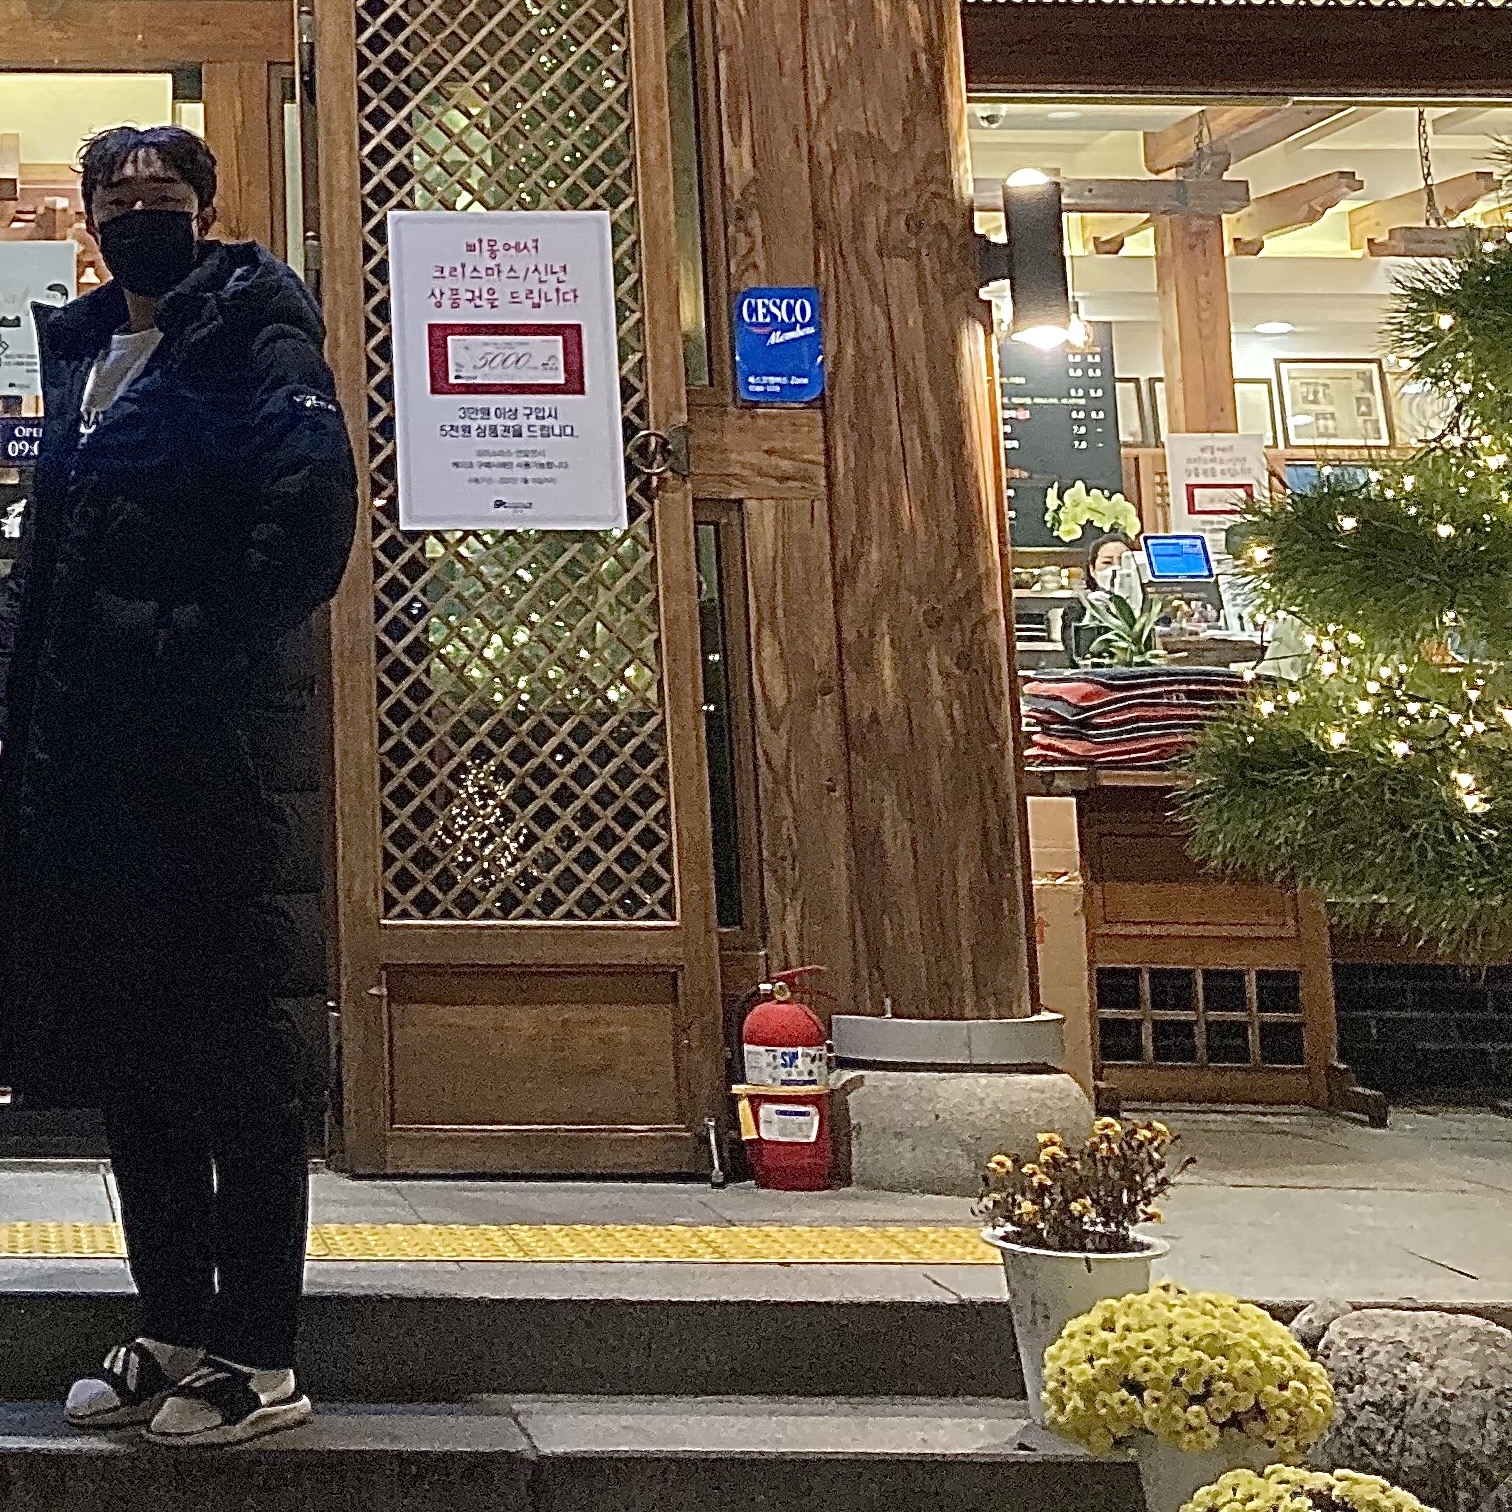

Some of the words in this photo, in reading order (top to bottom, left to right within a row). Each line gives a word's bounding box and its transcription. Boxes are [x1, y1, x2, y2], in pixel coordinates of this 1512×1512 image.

[427, 287, 499, 309] 상품권을
[508, 287, 579, 309] 드립니다
[742, 298, 812, 323] CESCO
[473, 352, 532, 370] 5000
[458, 406, 491, 420] 3만원
[494, 406, 518, 420] 이상
[522, 406, 558, 420] 구입시
